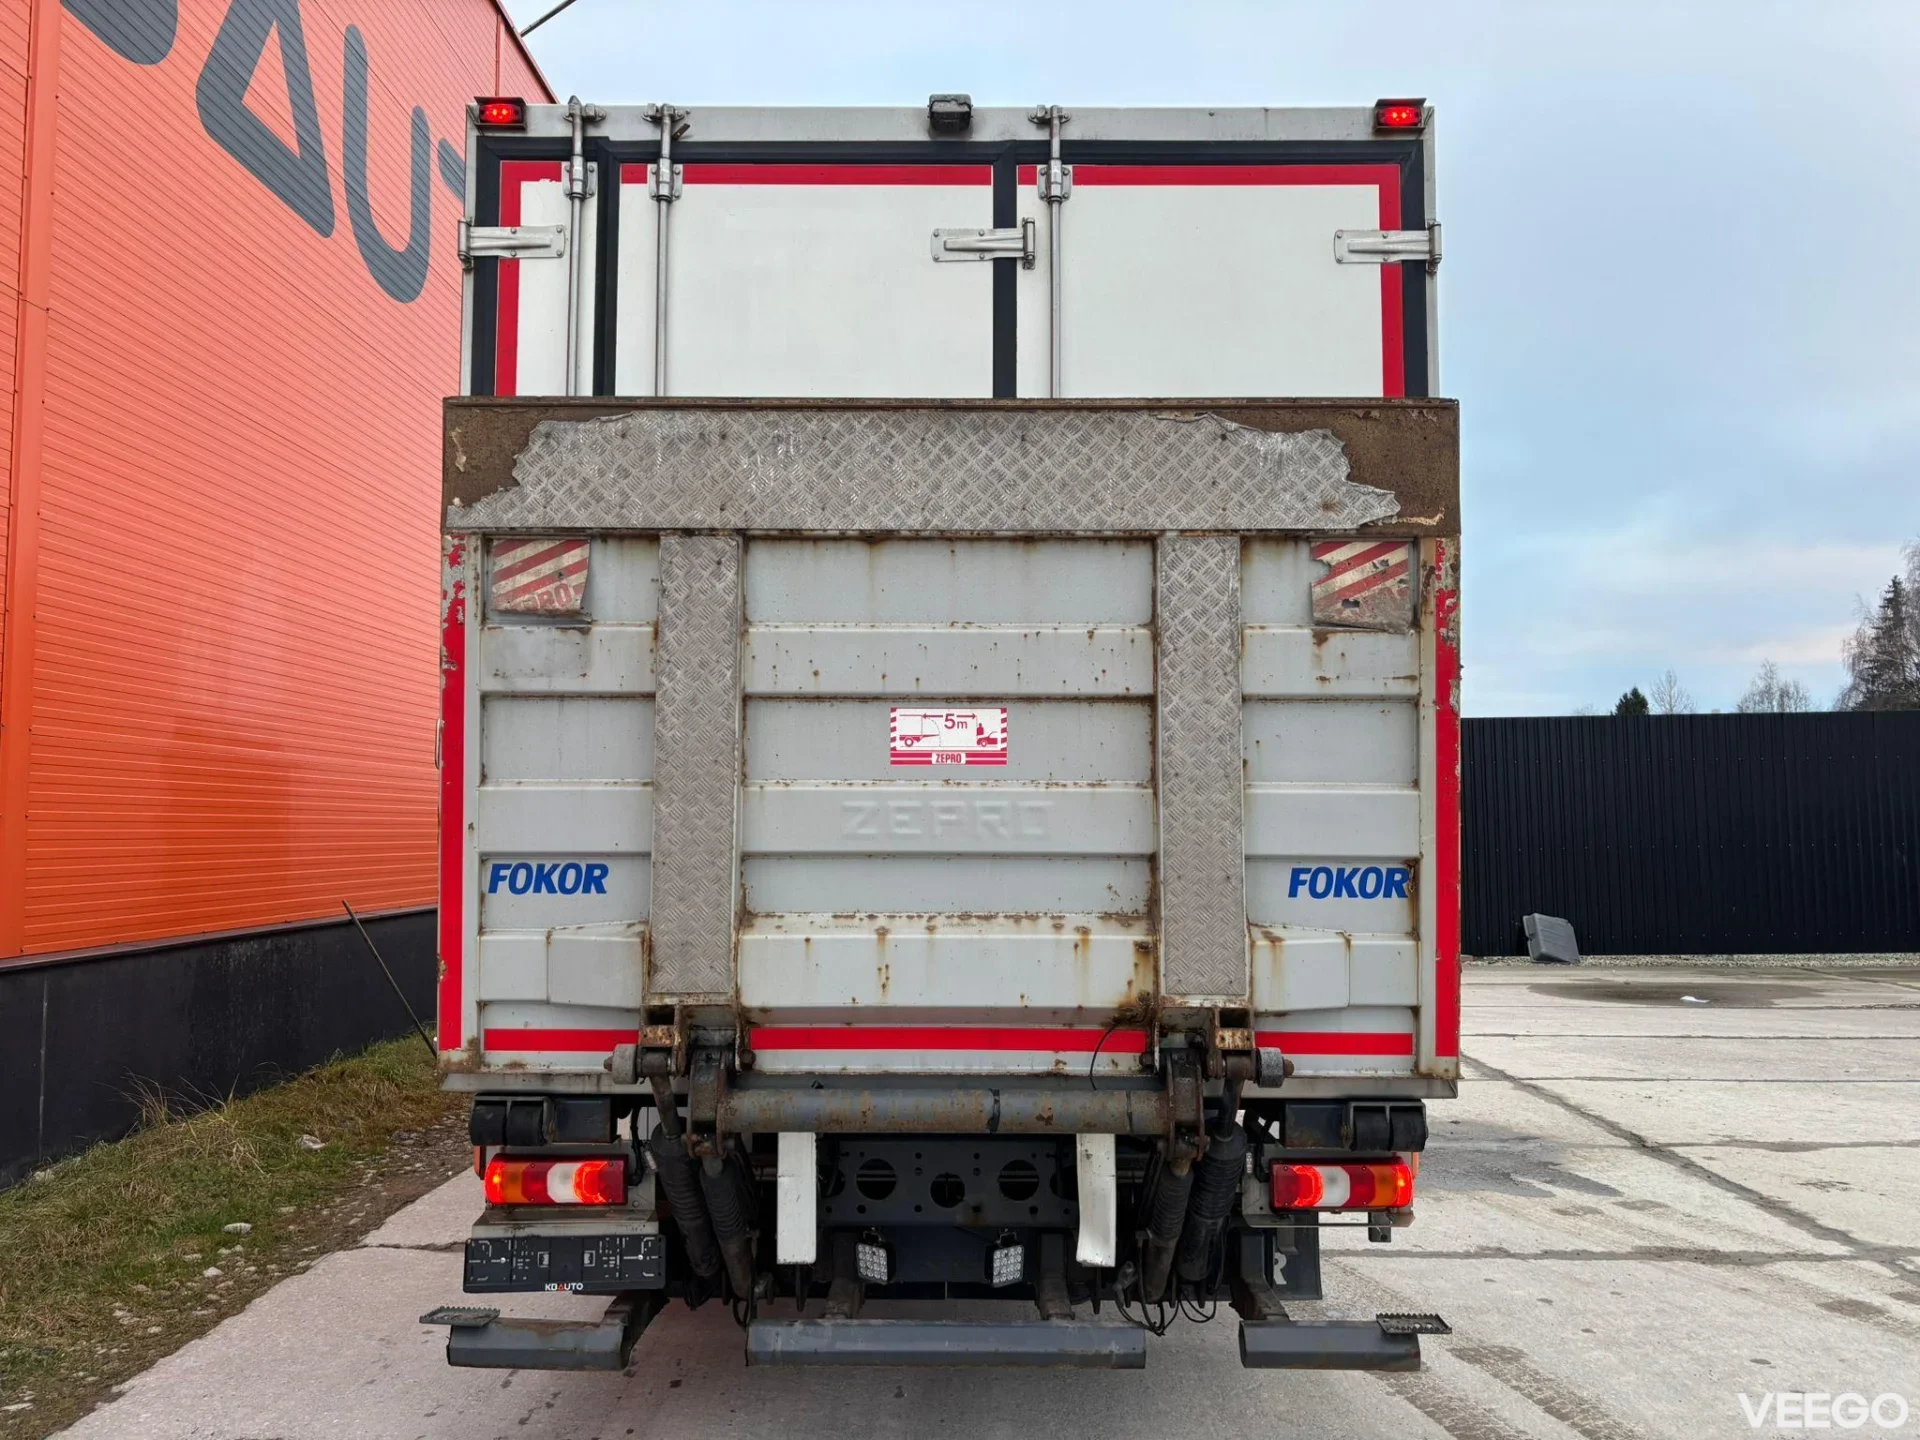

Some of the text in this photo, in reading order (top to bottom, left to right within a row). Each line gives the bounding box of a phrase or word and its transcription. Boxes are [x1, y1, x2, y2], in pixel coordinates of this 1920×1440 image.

[935, 753, 962, 764] ZEPRO
[488, 862, 609, 895] FOKOR
[1288, 866, 1410, 899] FOKOR
[545, 1282, 584, 1291] KDAUTO
